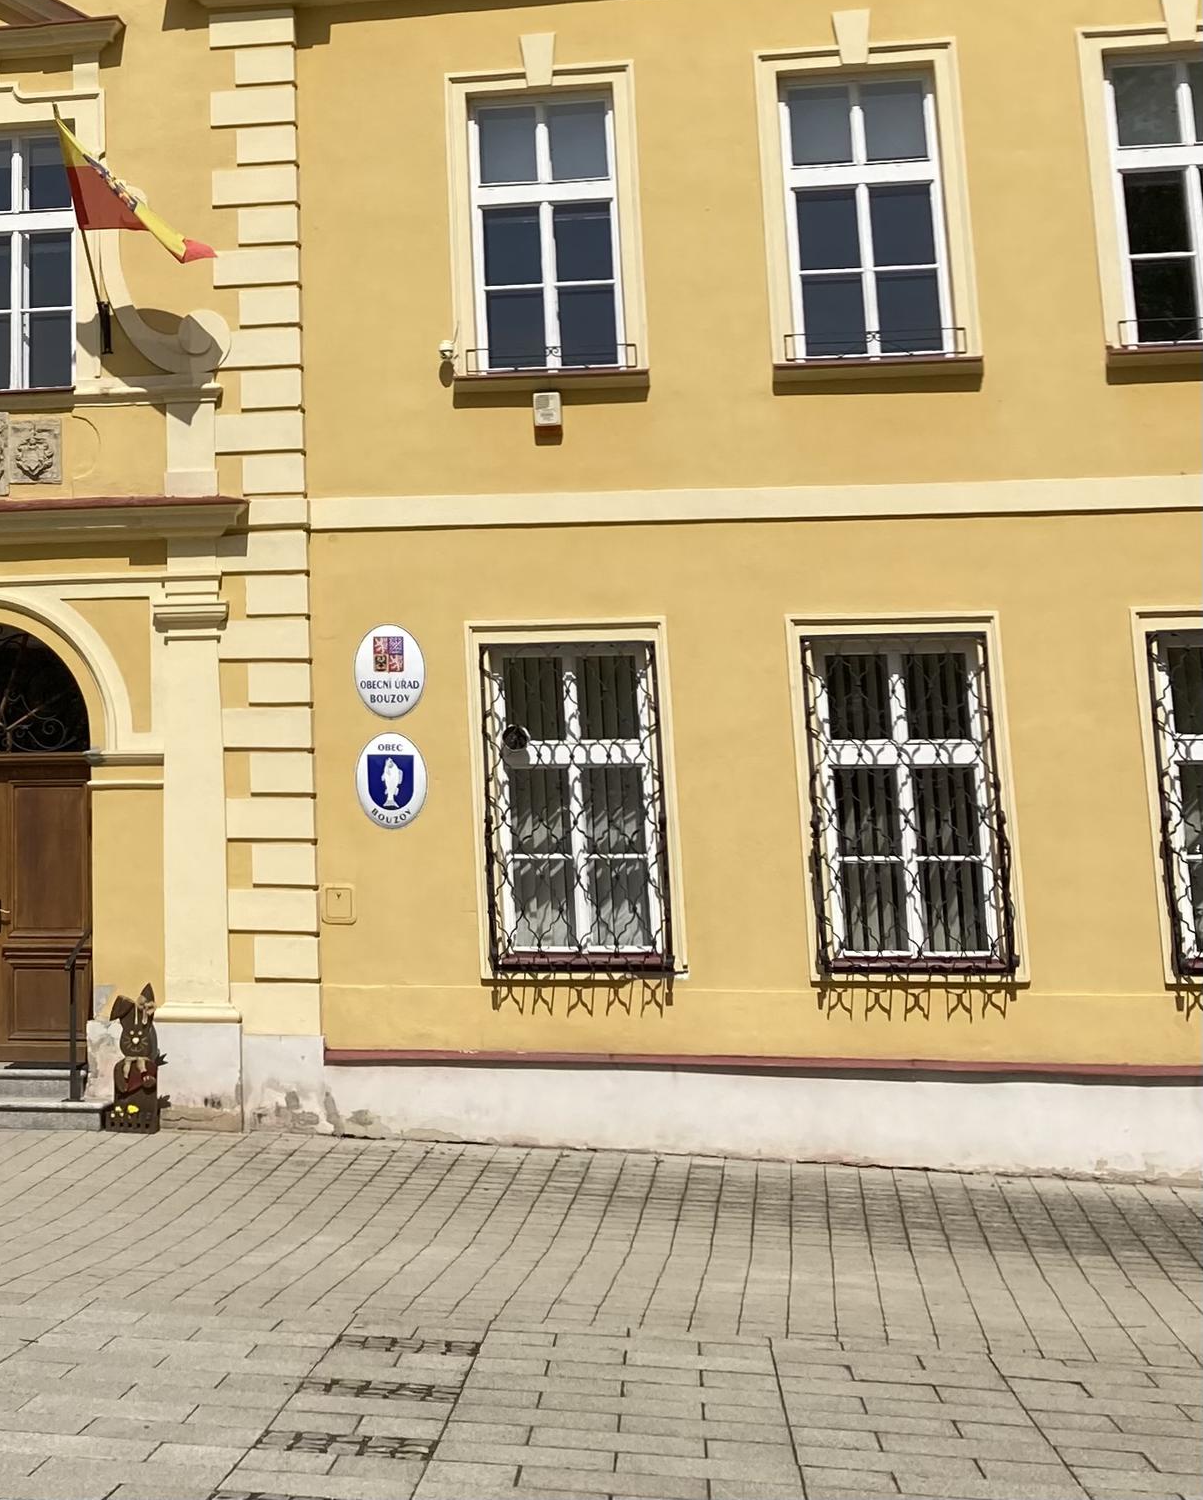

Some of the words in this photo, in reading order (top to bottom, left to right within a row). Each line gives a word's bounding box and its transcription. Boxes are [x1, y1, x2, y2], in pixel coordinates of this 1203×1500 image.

[360, 677, 392, 689] OBECNÍ
[394, 677, 420, 689] ÚŘAD
[370, 694, 410, 703] BOUZOV
[377, 743, 403, 752] OBEC
[371, 808, 411, 824] BOUZOV
